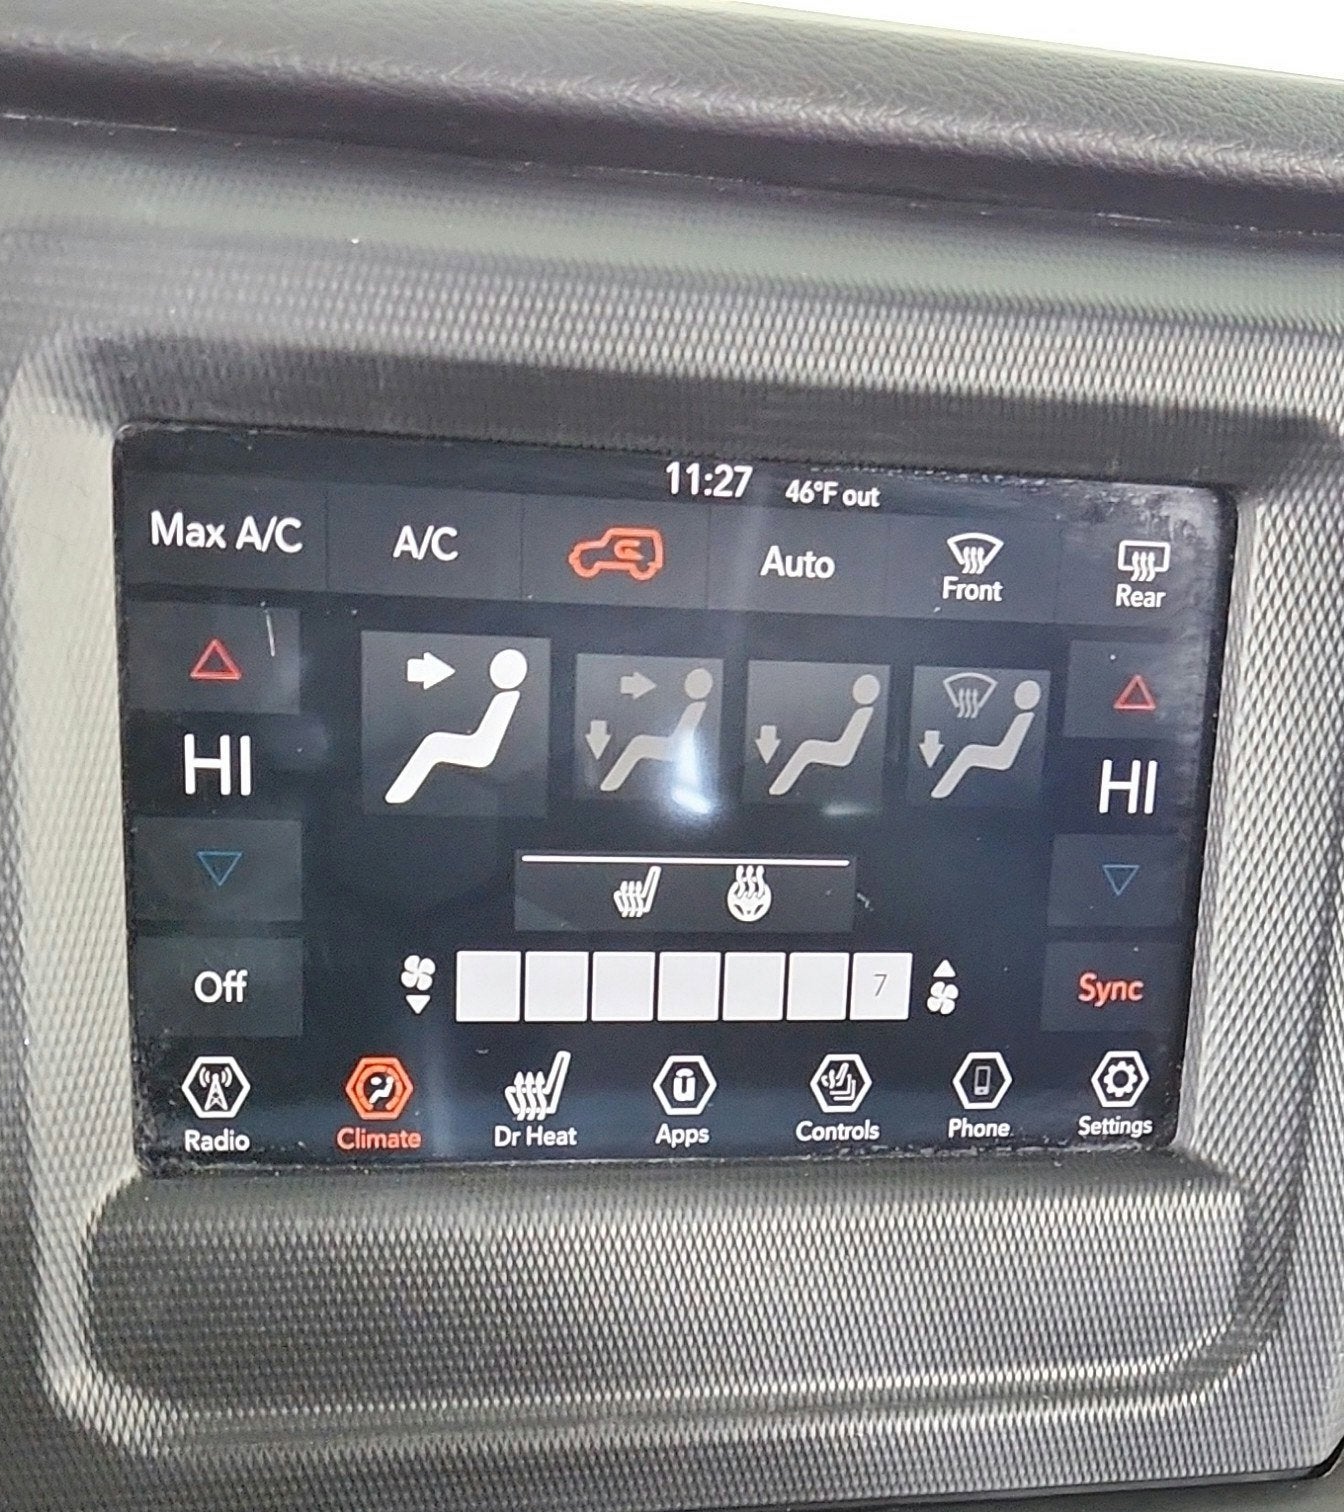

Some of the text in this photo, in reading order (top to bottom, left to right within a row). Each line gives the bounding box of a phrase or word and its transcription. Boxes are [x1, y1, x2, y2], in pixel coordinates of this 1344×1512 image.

[666, 461, 754, 498] 11:27
[785, 479, 881, 508] 46°F out
[151, 509, 303, 554] Max A/C
[392, 524, 459, 562] A/C
[760, 544, 836, 579] Auto
[942, 575, 1004, 602] Front
[1115, 583, 1167, 608] Rear
[184, 733, 252, 796] HI
[1098, 759, 1158, 814] HI
[194, 969, 248, 1003] Off
[873, 972, 889, 998] 7
[1078, 972, 1144, 1007] Sync
[184, 1127, 250, 1152] Radio
[336, 1127, 422, 1150] Climate
[494, 1125, 578, 1147] Dr Heat
[655, 1123, 710, 1148] Apps
[795, 1118, 880, 1142] Controls
[948, 1117, 1011, 1138] Phone
[1078, 1115, 1153, 1139] Settings
